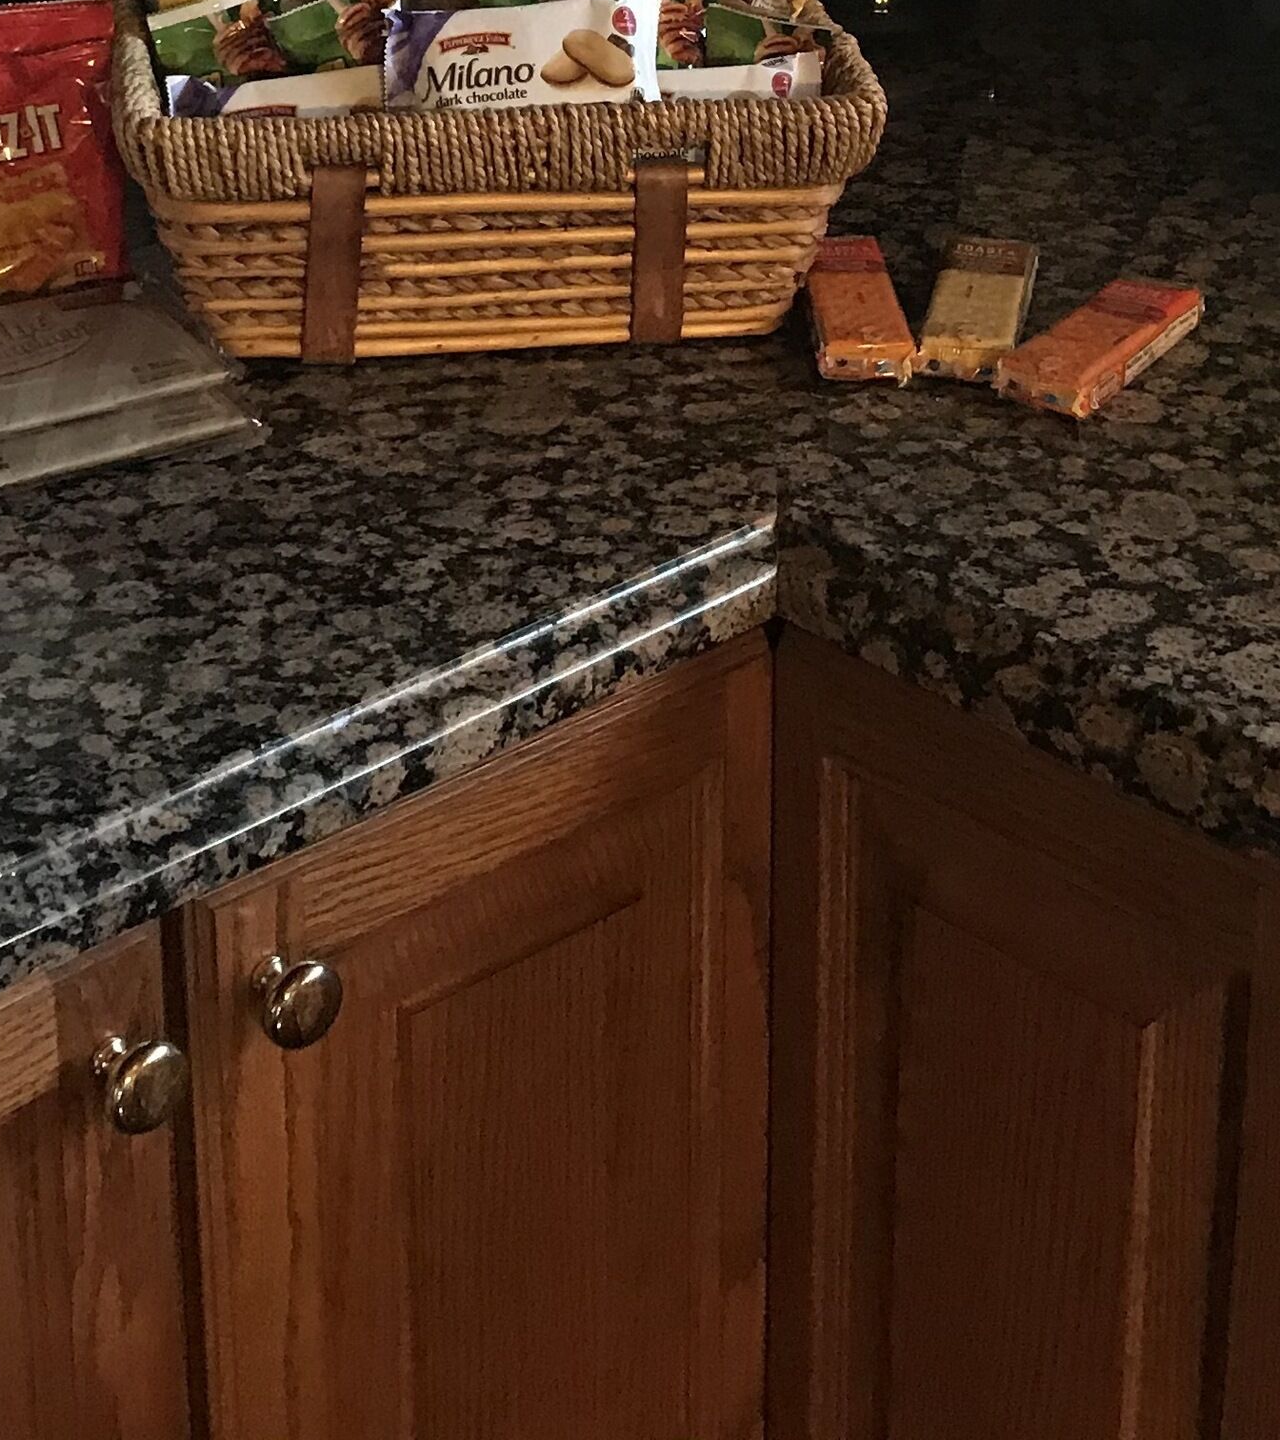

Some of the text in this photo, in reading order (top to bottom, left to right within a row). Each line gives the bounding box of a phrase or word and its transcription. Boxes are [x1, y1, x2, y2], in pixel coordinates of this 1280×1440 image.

[422, 58, 535, 102] Milano
[436, 88, 528, 108] dark chocolate
